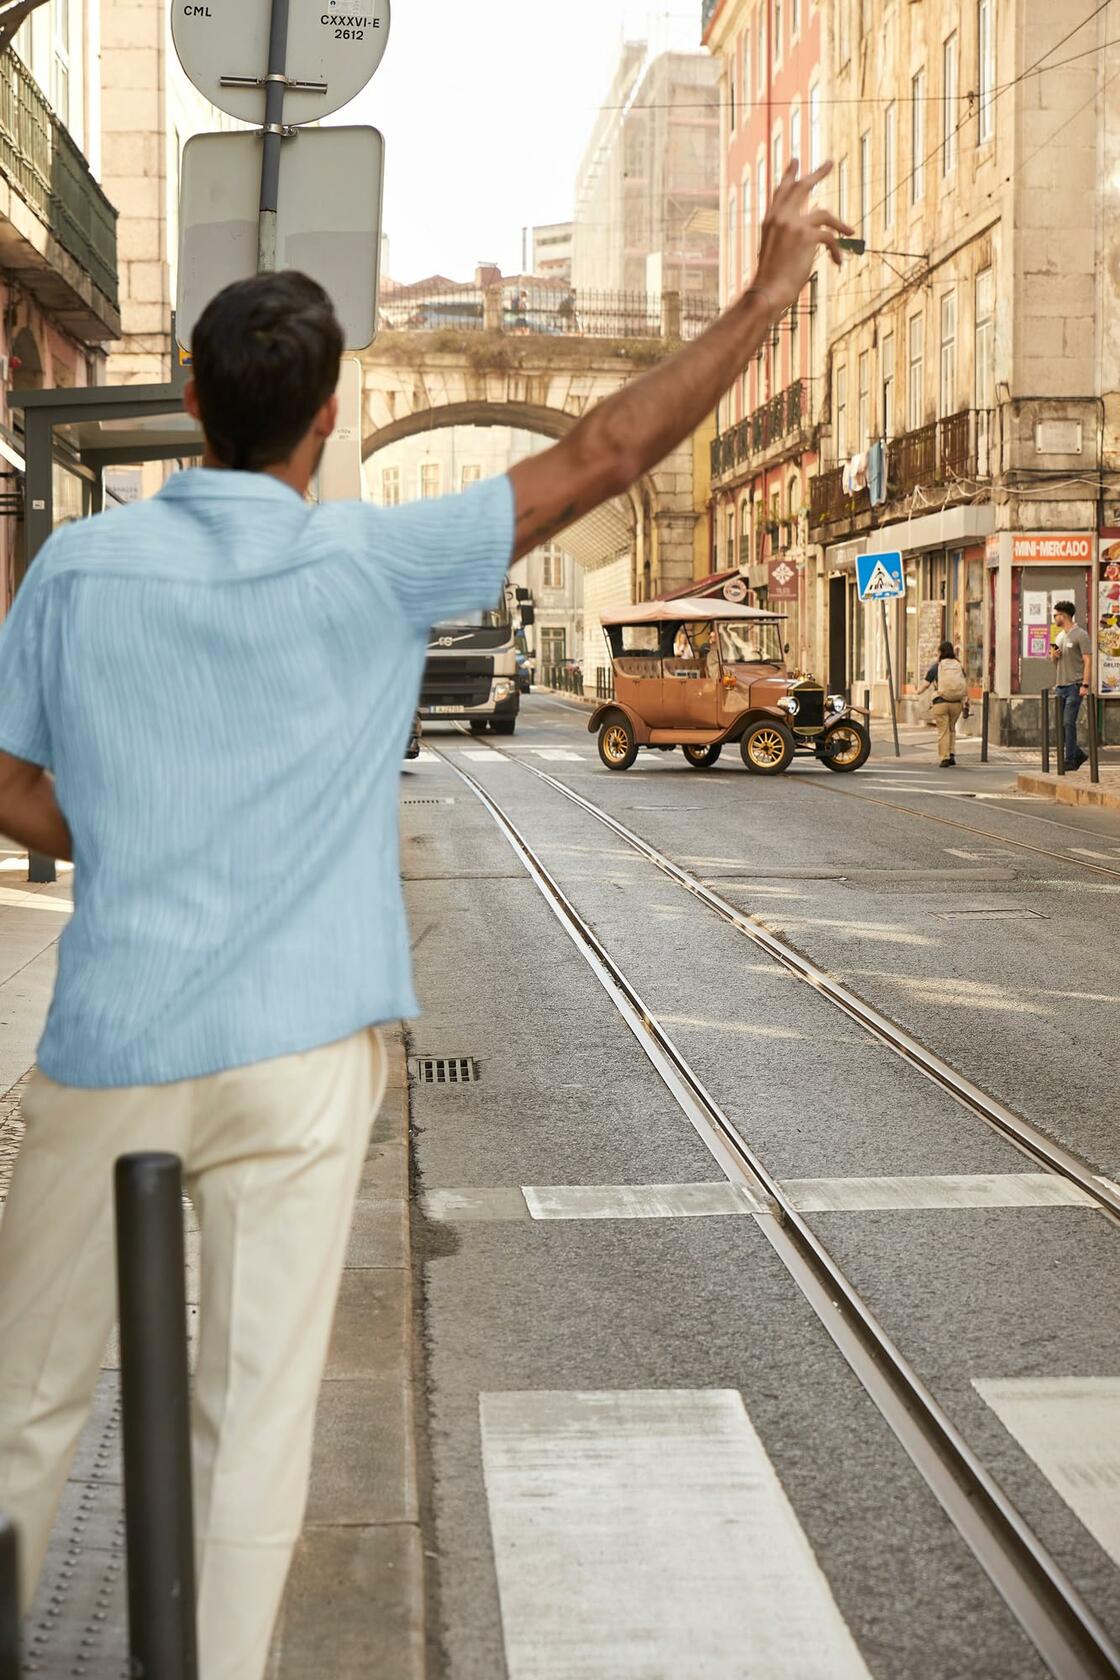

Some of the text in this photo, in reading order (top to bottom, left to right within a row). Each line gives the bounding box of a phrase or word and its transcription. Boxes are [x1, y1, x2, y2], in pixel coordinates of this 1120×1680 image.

[184, 5, 212, 17] CML
[320, 14, 380, 28] CXXXVI-E
[334, 28, 364, 41] 2612
[1015, 540, 1089, 557] MINI-MERCADO
